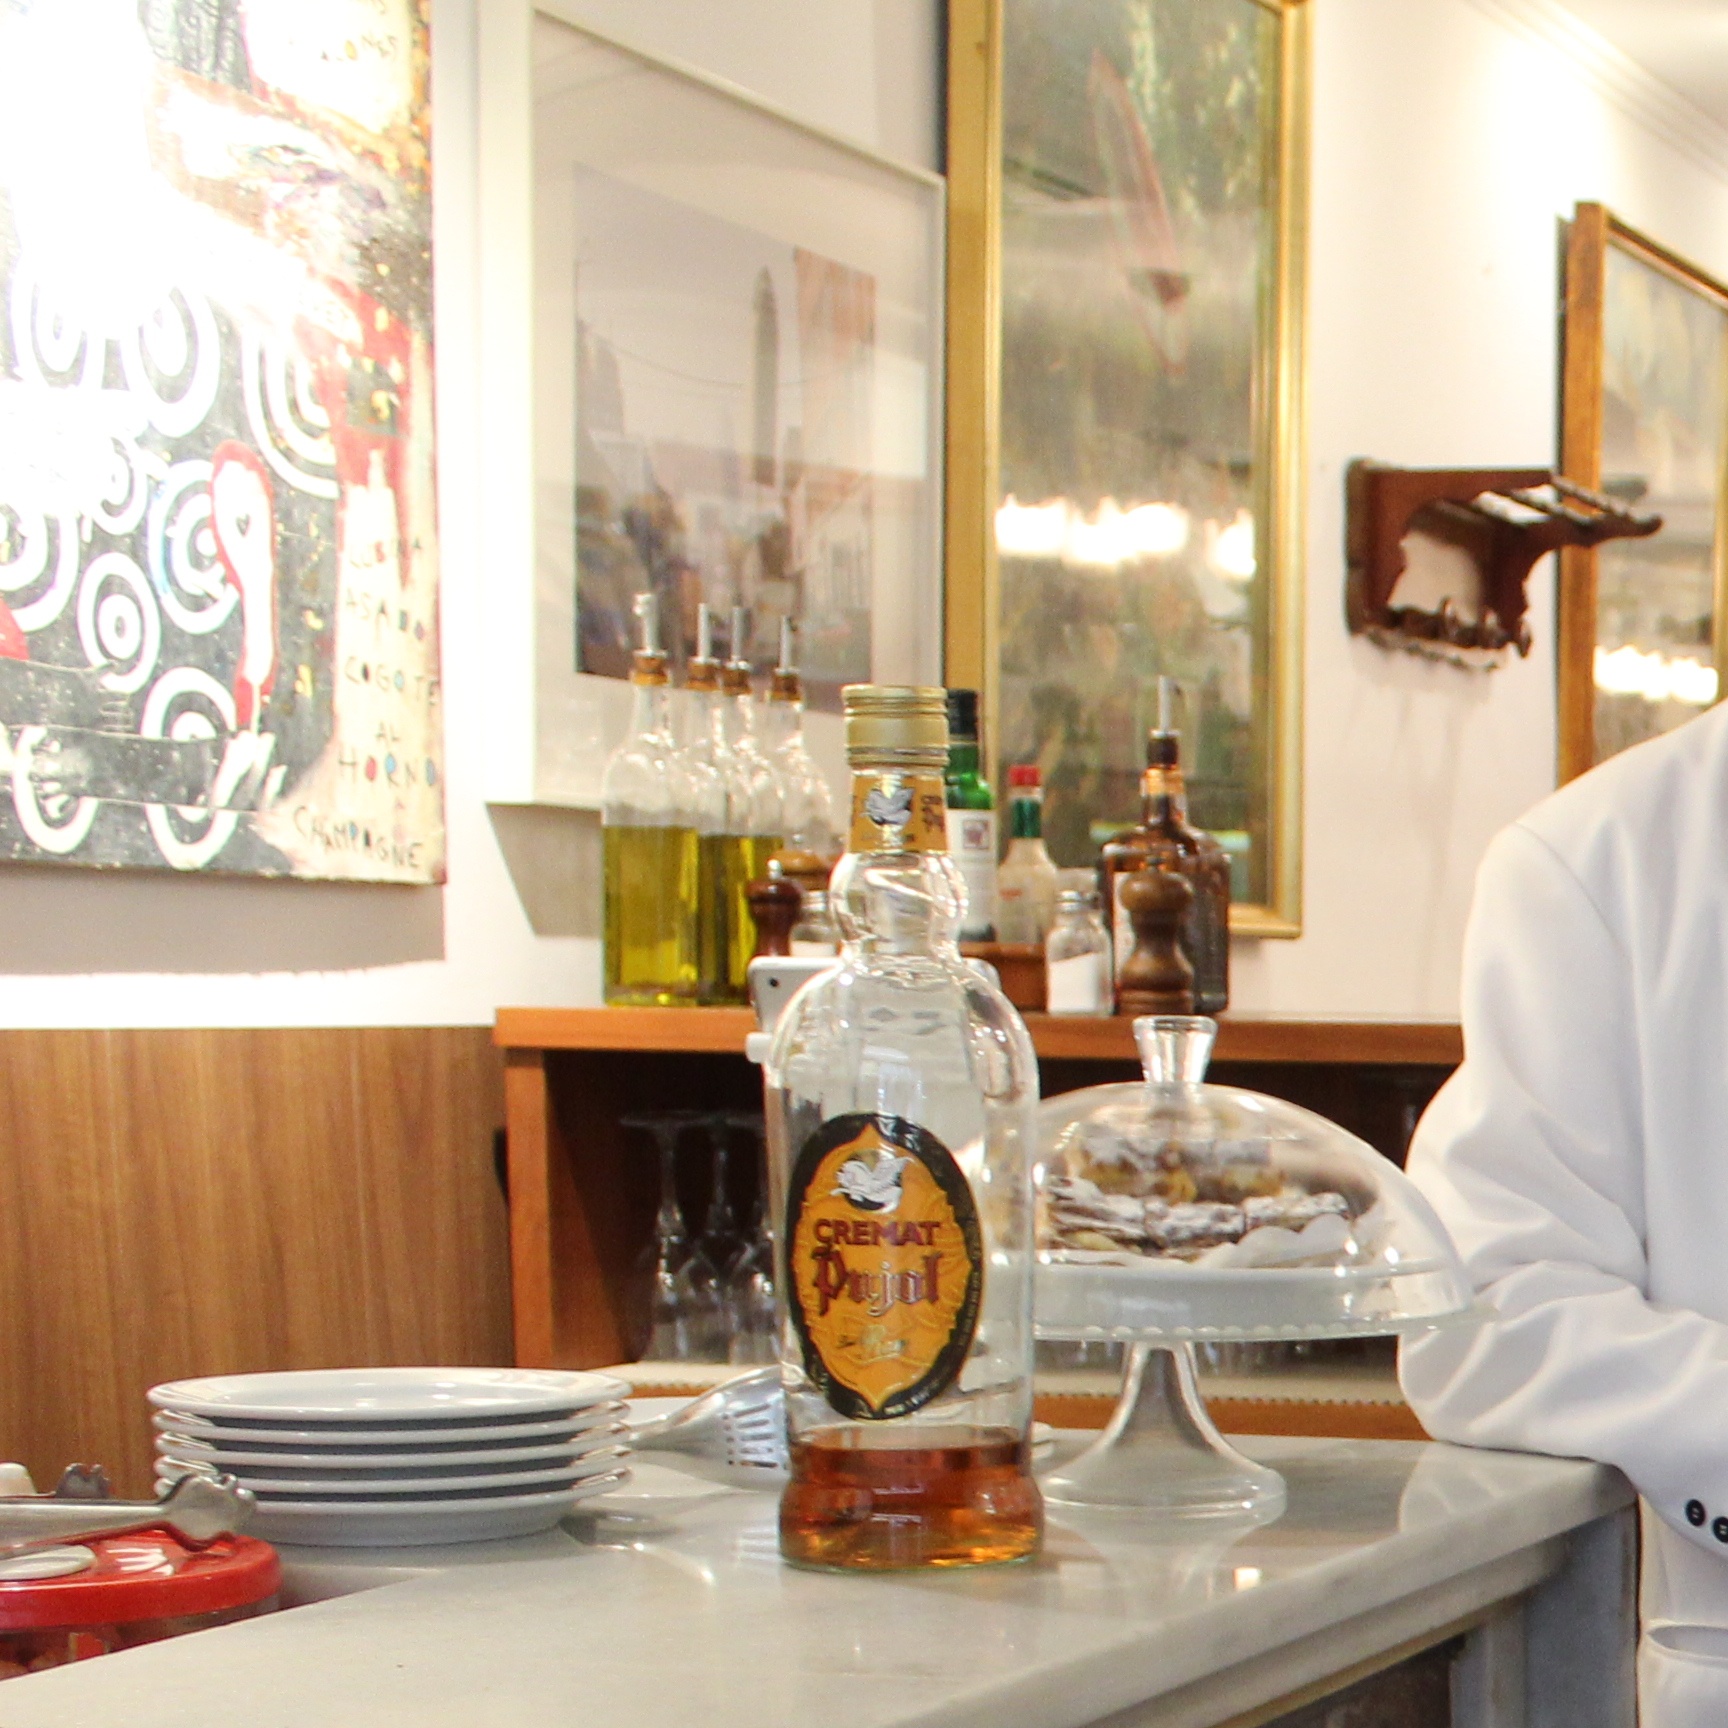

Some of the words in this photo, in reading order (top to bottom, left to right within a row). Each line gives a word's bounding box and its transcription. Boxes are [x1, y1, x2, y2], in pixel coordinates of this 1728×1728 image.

[338, 740, 437, 788] HORNO
[813, 1219, 941, 1247] CREMAT
[811, 1246, 944, 1317] Pujol
